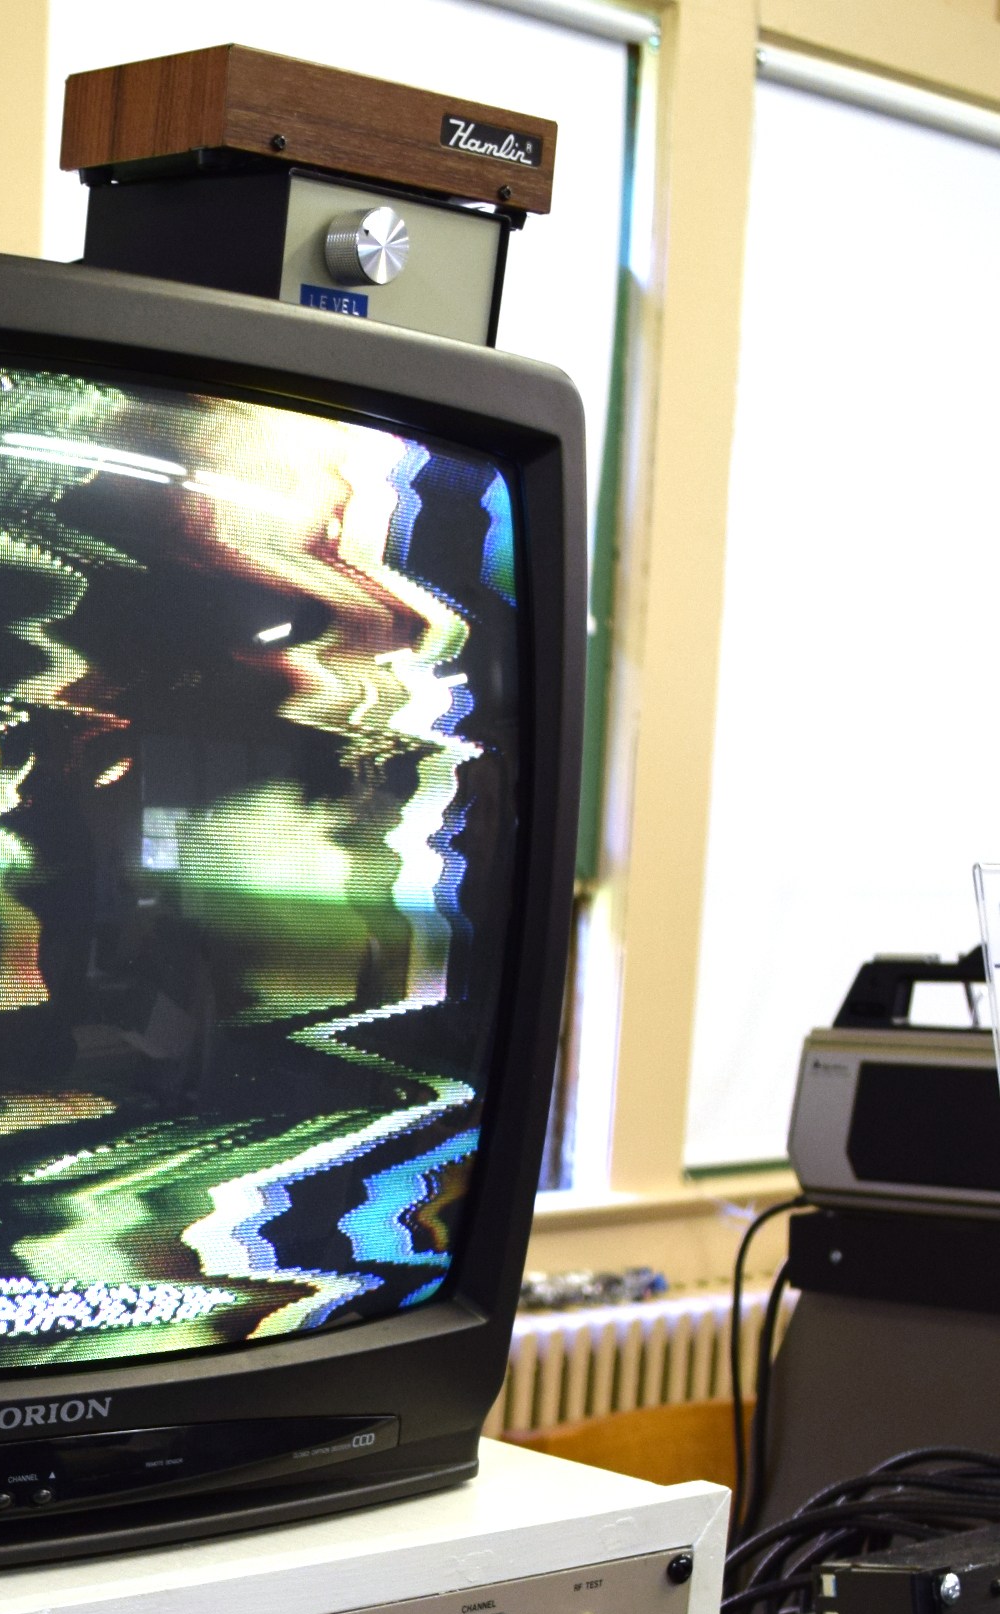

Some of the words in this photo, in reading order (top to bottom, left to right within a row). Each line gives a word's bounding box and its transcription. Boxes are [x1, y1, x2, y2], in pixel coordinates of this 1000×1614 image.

[448, 118, 532, 165] Hamlin
[309, 294, 360, 316] LEVEL
[7, 1473, 39, 1483] CHANNEL
[585, 1579, 603, 1590] TEST
[461, 1600, 496, 1614] CHANNEL
